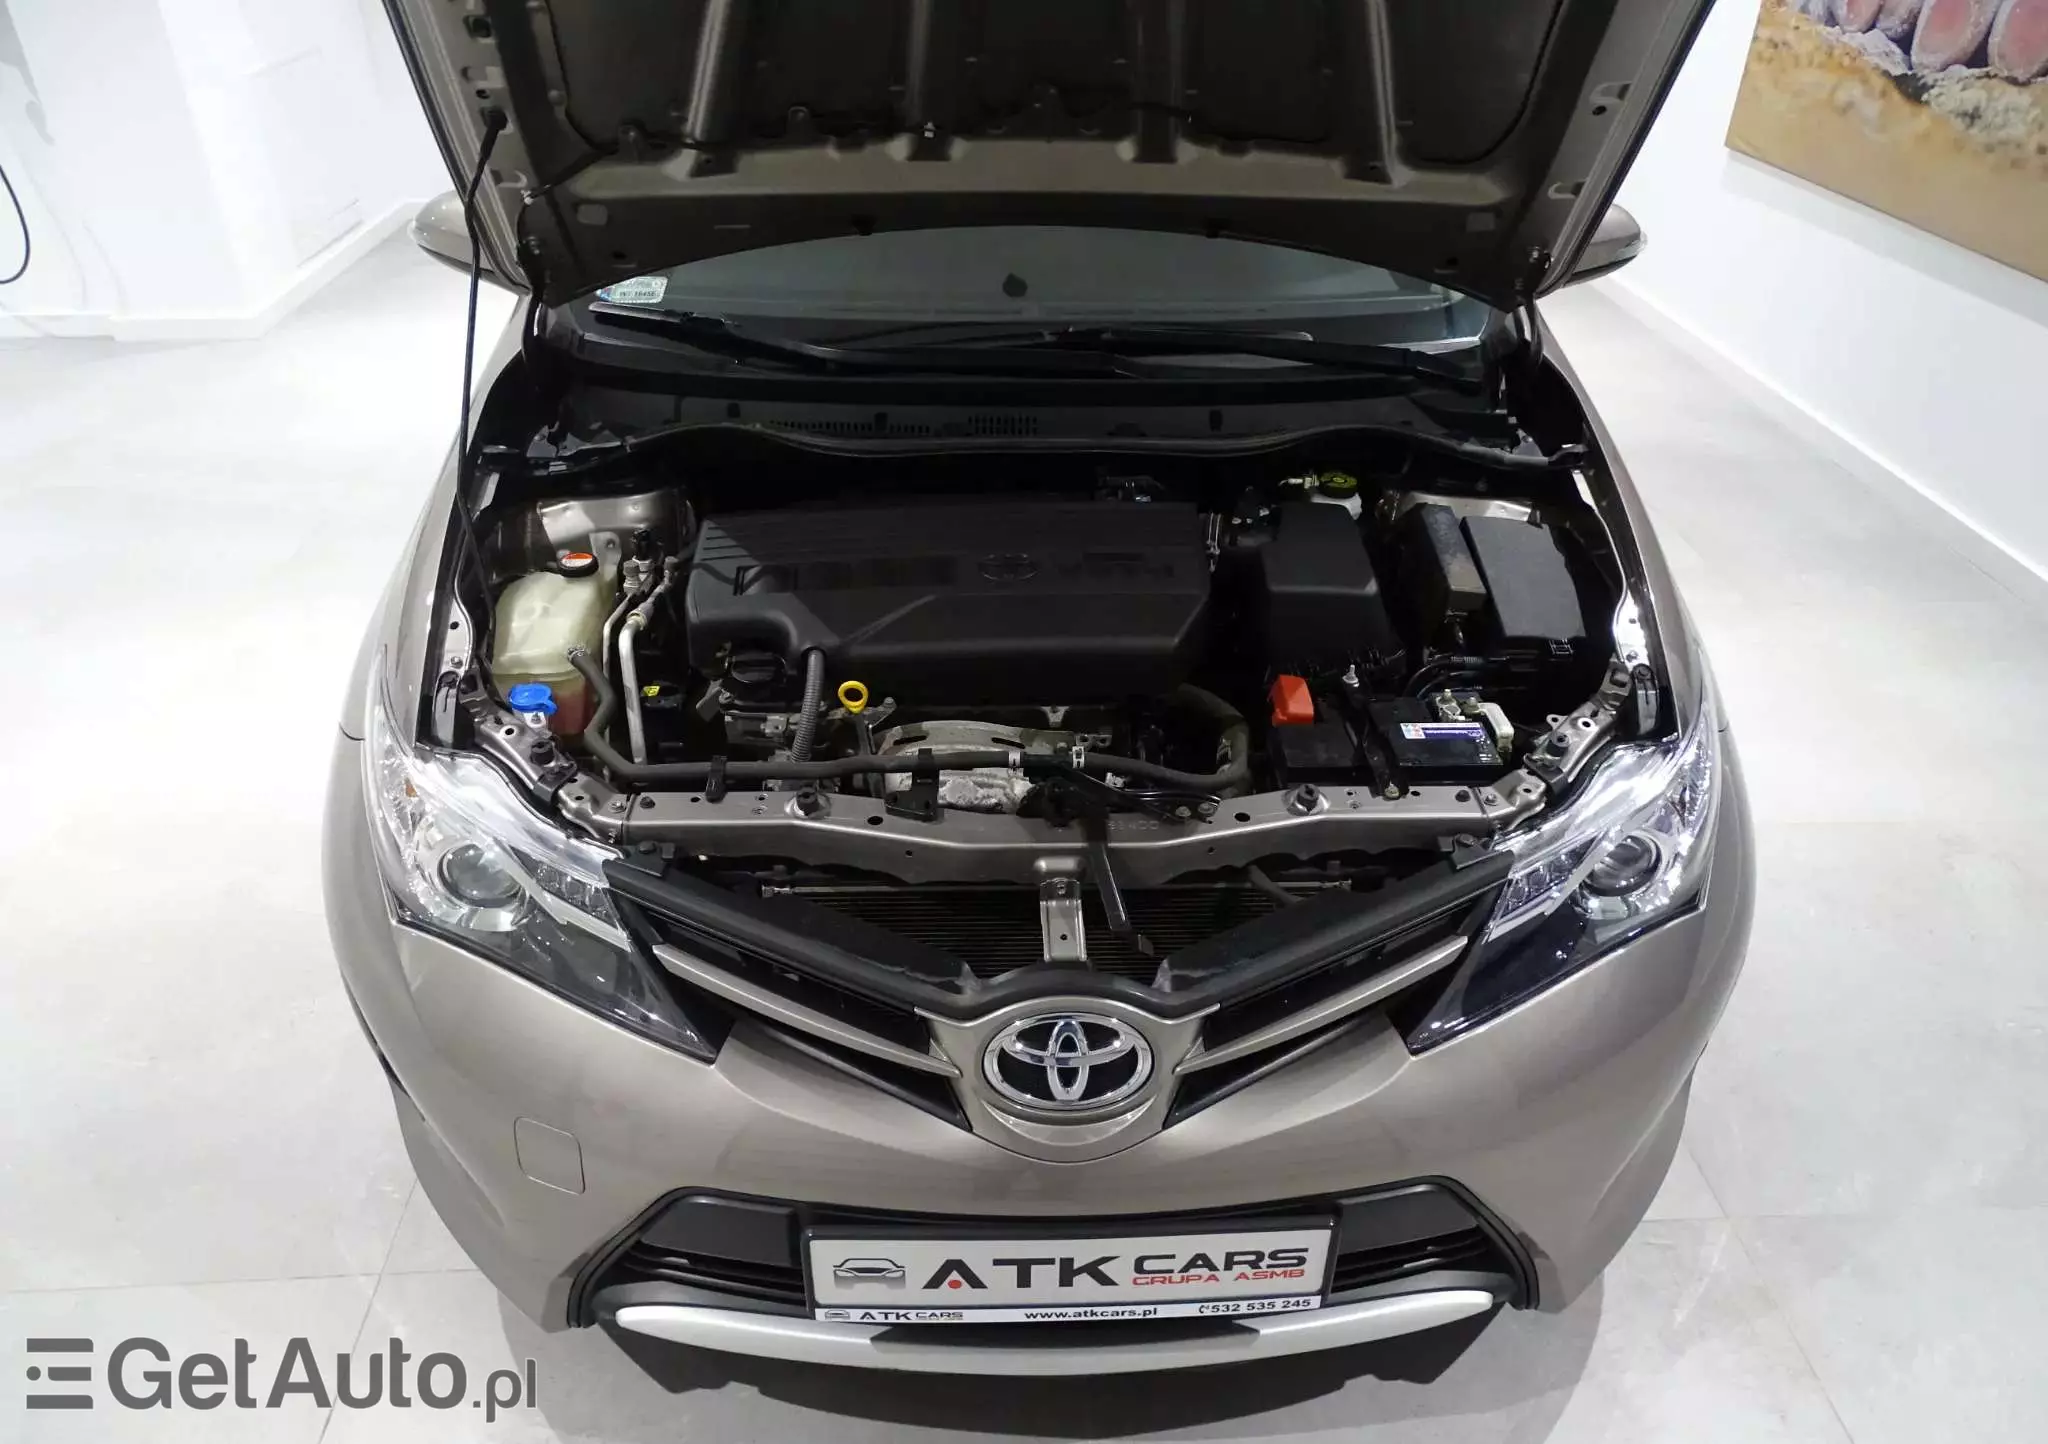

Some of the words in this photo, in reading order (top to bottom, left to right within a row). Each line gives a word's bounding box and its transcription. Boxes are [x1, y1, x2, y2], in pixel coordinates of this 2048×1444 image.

[921, 1255, 1121, 1289] ATK
[1133, 1247, 1309, 1275] CARS
[1132, 1273, 1220, 1286] GRUPA
[1234, 1268, 1306, 1282] ASMB
[1024, 1307, 1158, 1320] www.atkcars.pl
[1210, 1304, 1242, 1314] 532
[1246, 1301, 1277, 1311] 535
[1281, 1298, 1312, 1308] 245
[859, 1311, 911, 1321] ATK
[914, 1311, 964, 1319] CARS
